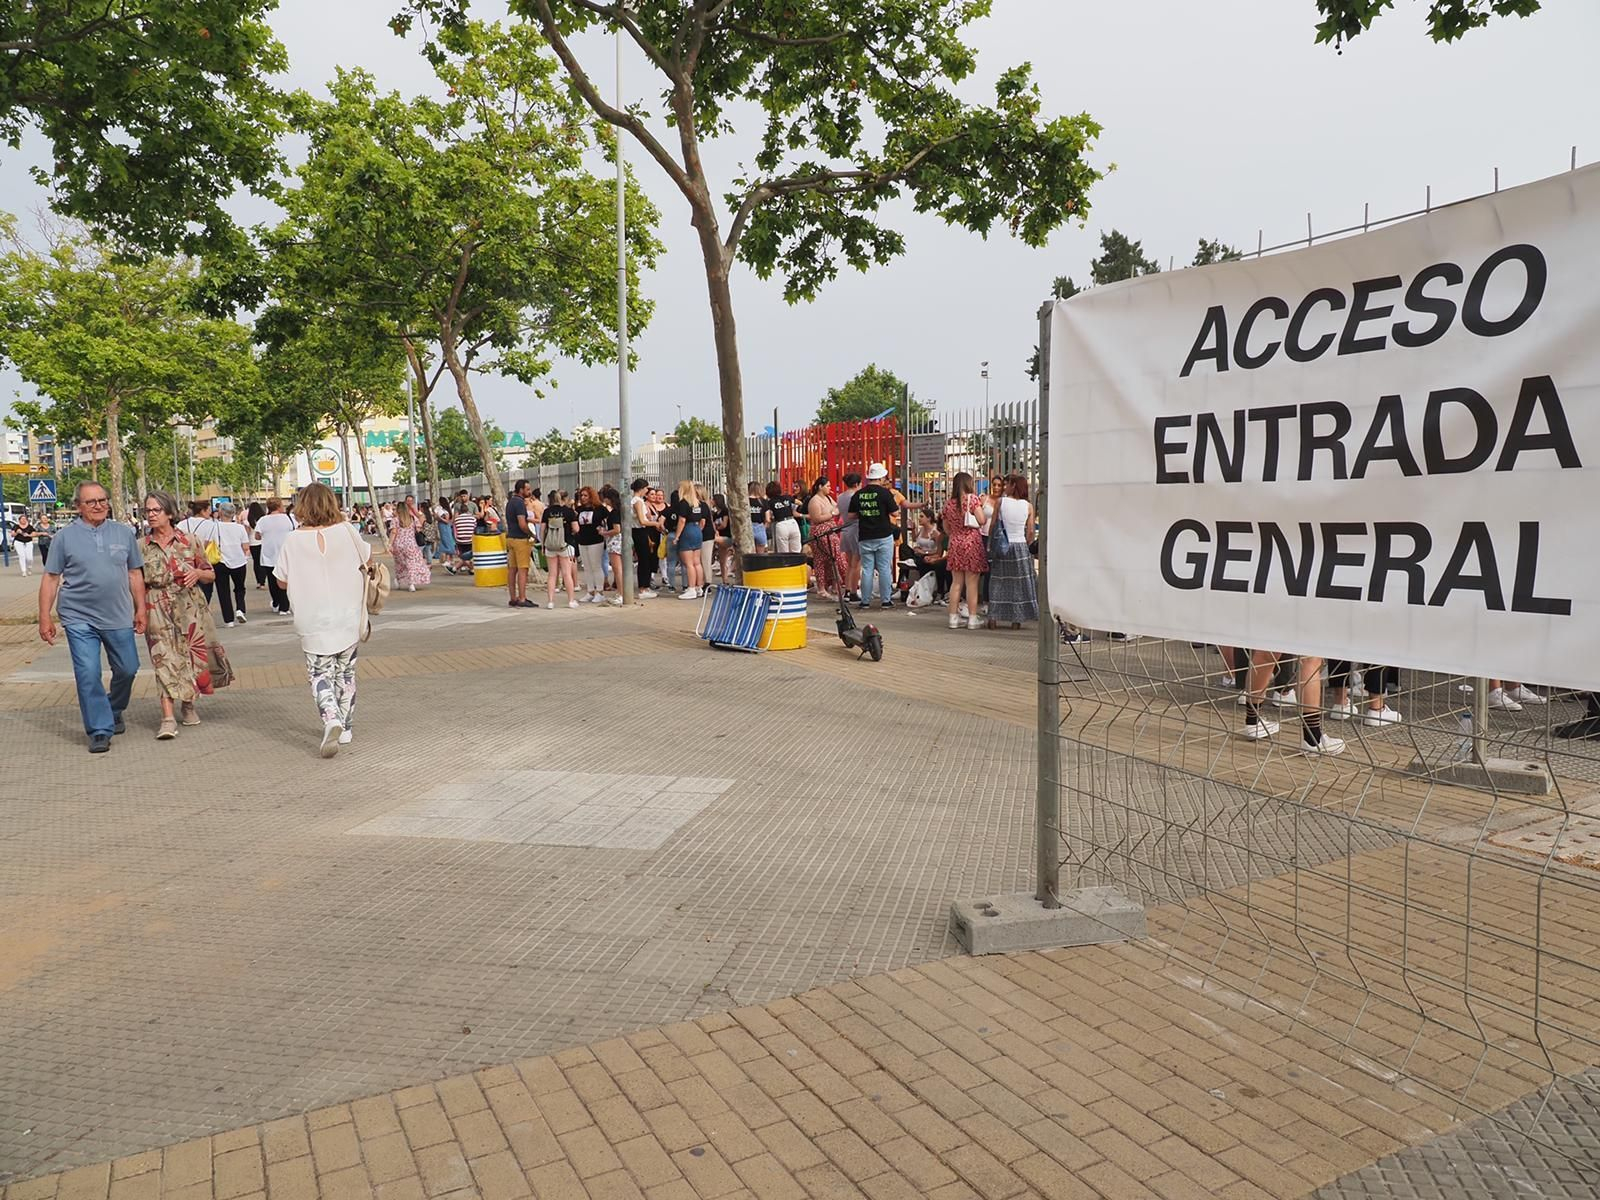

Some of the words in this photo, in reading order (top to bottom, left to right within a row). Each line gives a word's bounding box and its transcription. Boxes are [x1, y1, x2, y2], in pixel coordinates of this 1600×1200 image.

[1180, 242, 1547, 378] ACCESO
[1153, 374, 1583, 485] ENTRADA
[859, 492, 879, 500] KEEP
[1161, 518, 1572, 616] GENERAL
